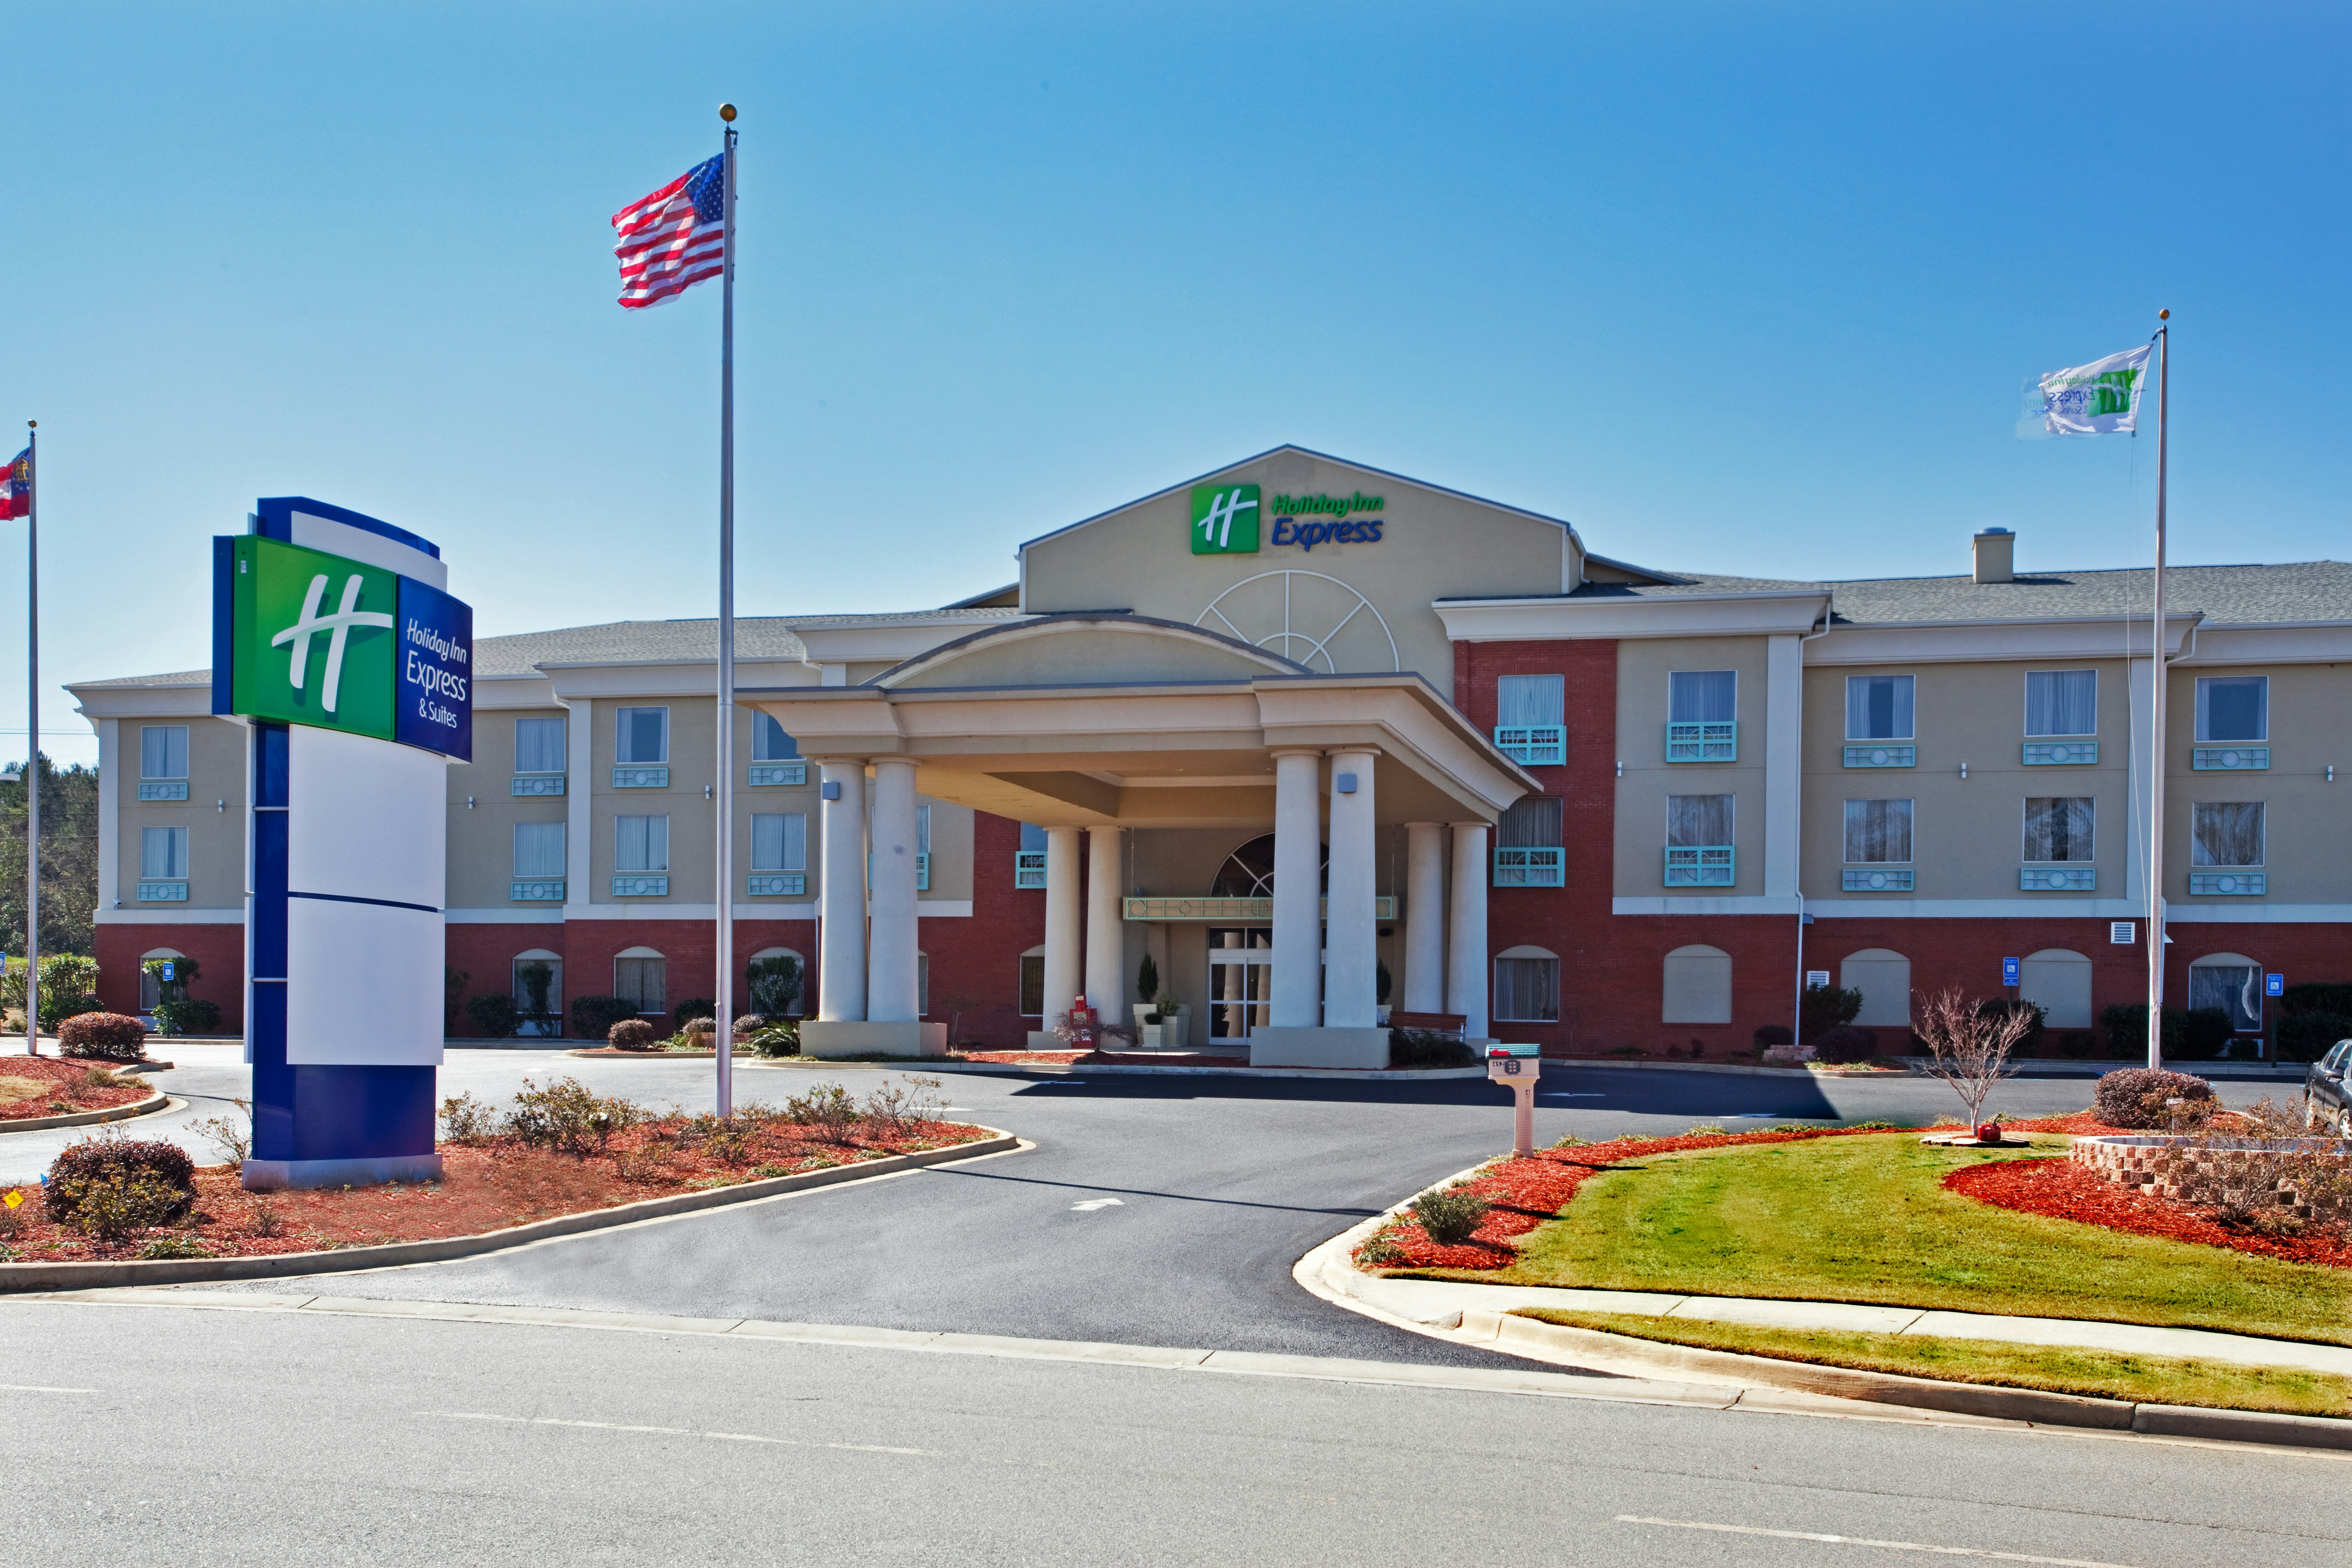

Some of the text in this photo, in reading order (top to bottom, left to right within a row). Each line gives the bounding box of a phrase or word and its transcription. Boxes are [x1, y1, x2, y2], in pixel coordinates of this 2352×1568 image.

[1272, 491, 1384, 518] Holiday Inn
[1272, 518, 1384, 552] Express
[407, 618, 466, 664] Holiday Inn
[407, 650, 466, 701] Express
[419, 698, 457, 728] & Suites
